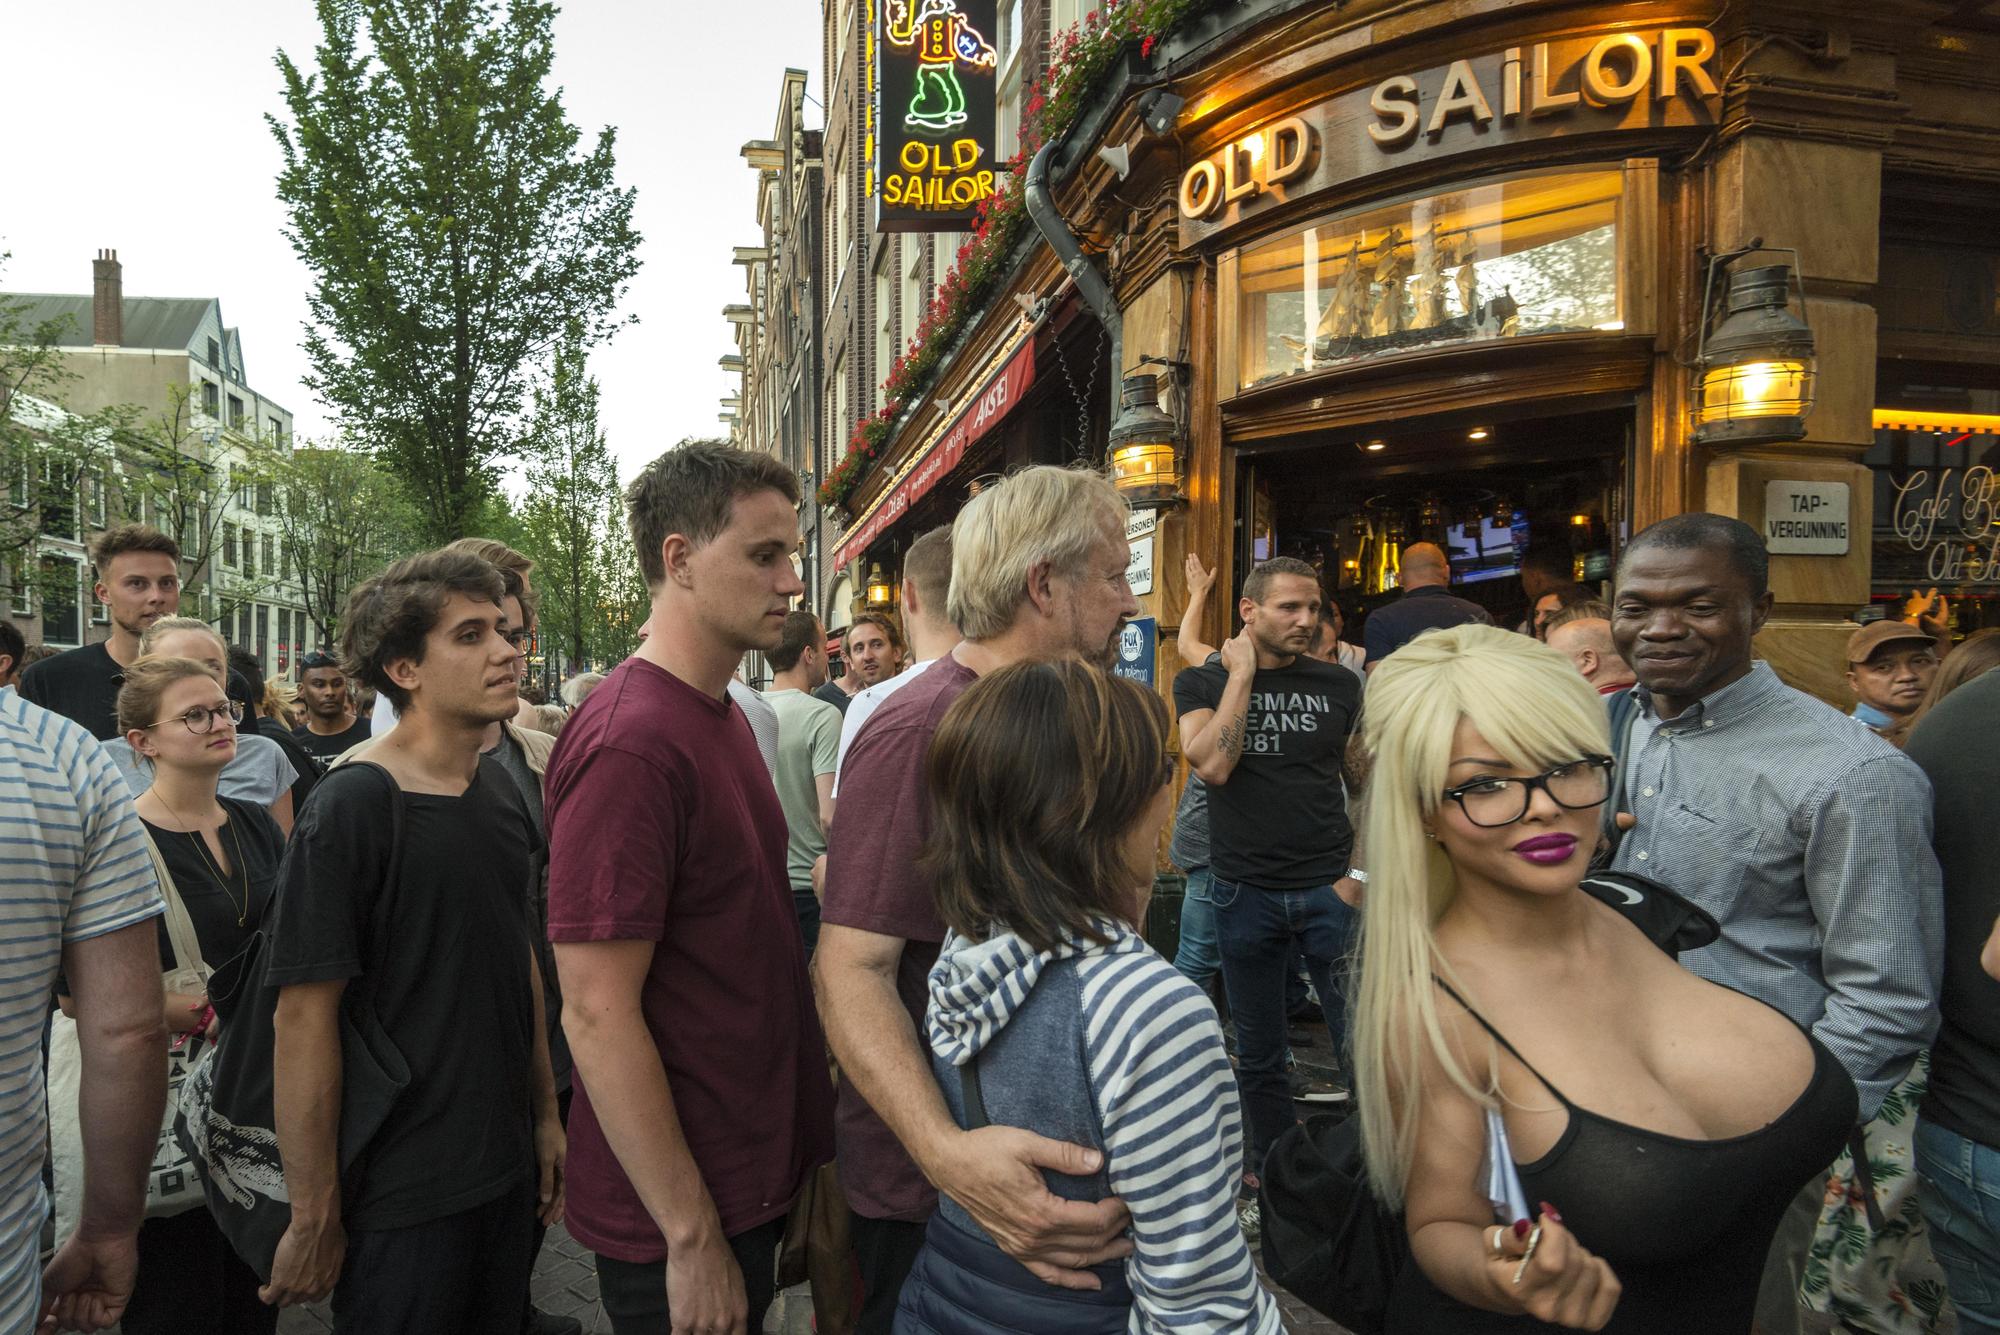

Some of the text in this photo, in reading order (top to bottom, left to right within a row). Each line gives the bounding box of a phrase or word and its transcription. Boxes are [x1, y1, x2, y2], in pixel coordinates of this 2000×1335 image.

[901, 139, 978, 171] OLD
[1179, 117, 1315, 220] OLD
[882, 170, 995, 207] SAILOR
[1790, 494, 1829, 513] TAP-
[1888, 468, 1953, 550] Café
[1127, 516, 1155, 536] ERSONEN
[1769, 520, 1847, 539] VERGUNNING
[1124, 631, 1138, 648] FOX
[1248, 692, 1330, 713] RMANI
[1246, 713, 1318, 732] EANS
[1242, 733, 1281, 753] 981
